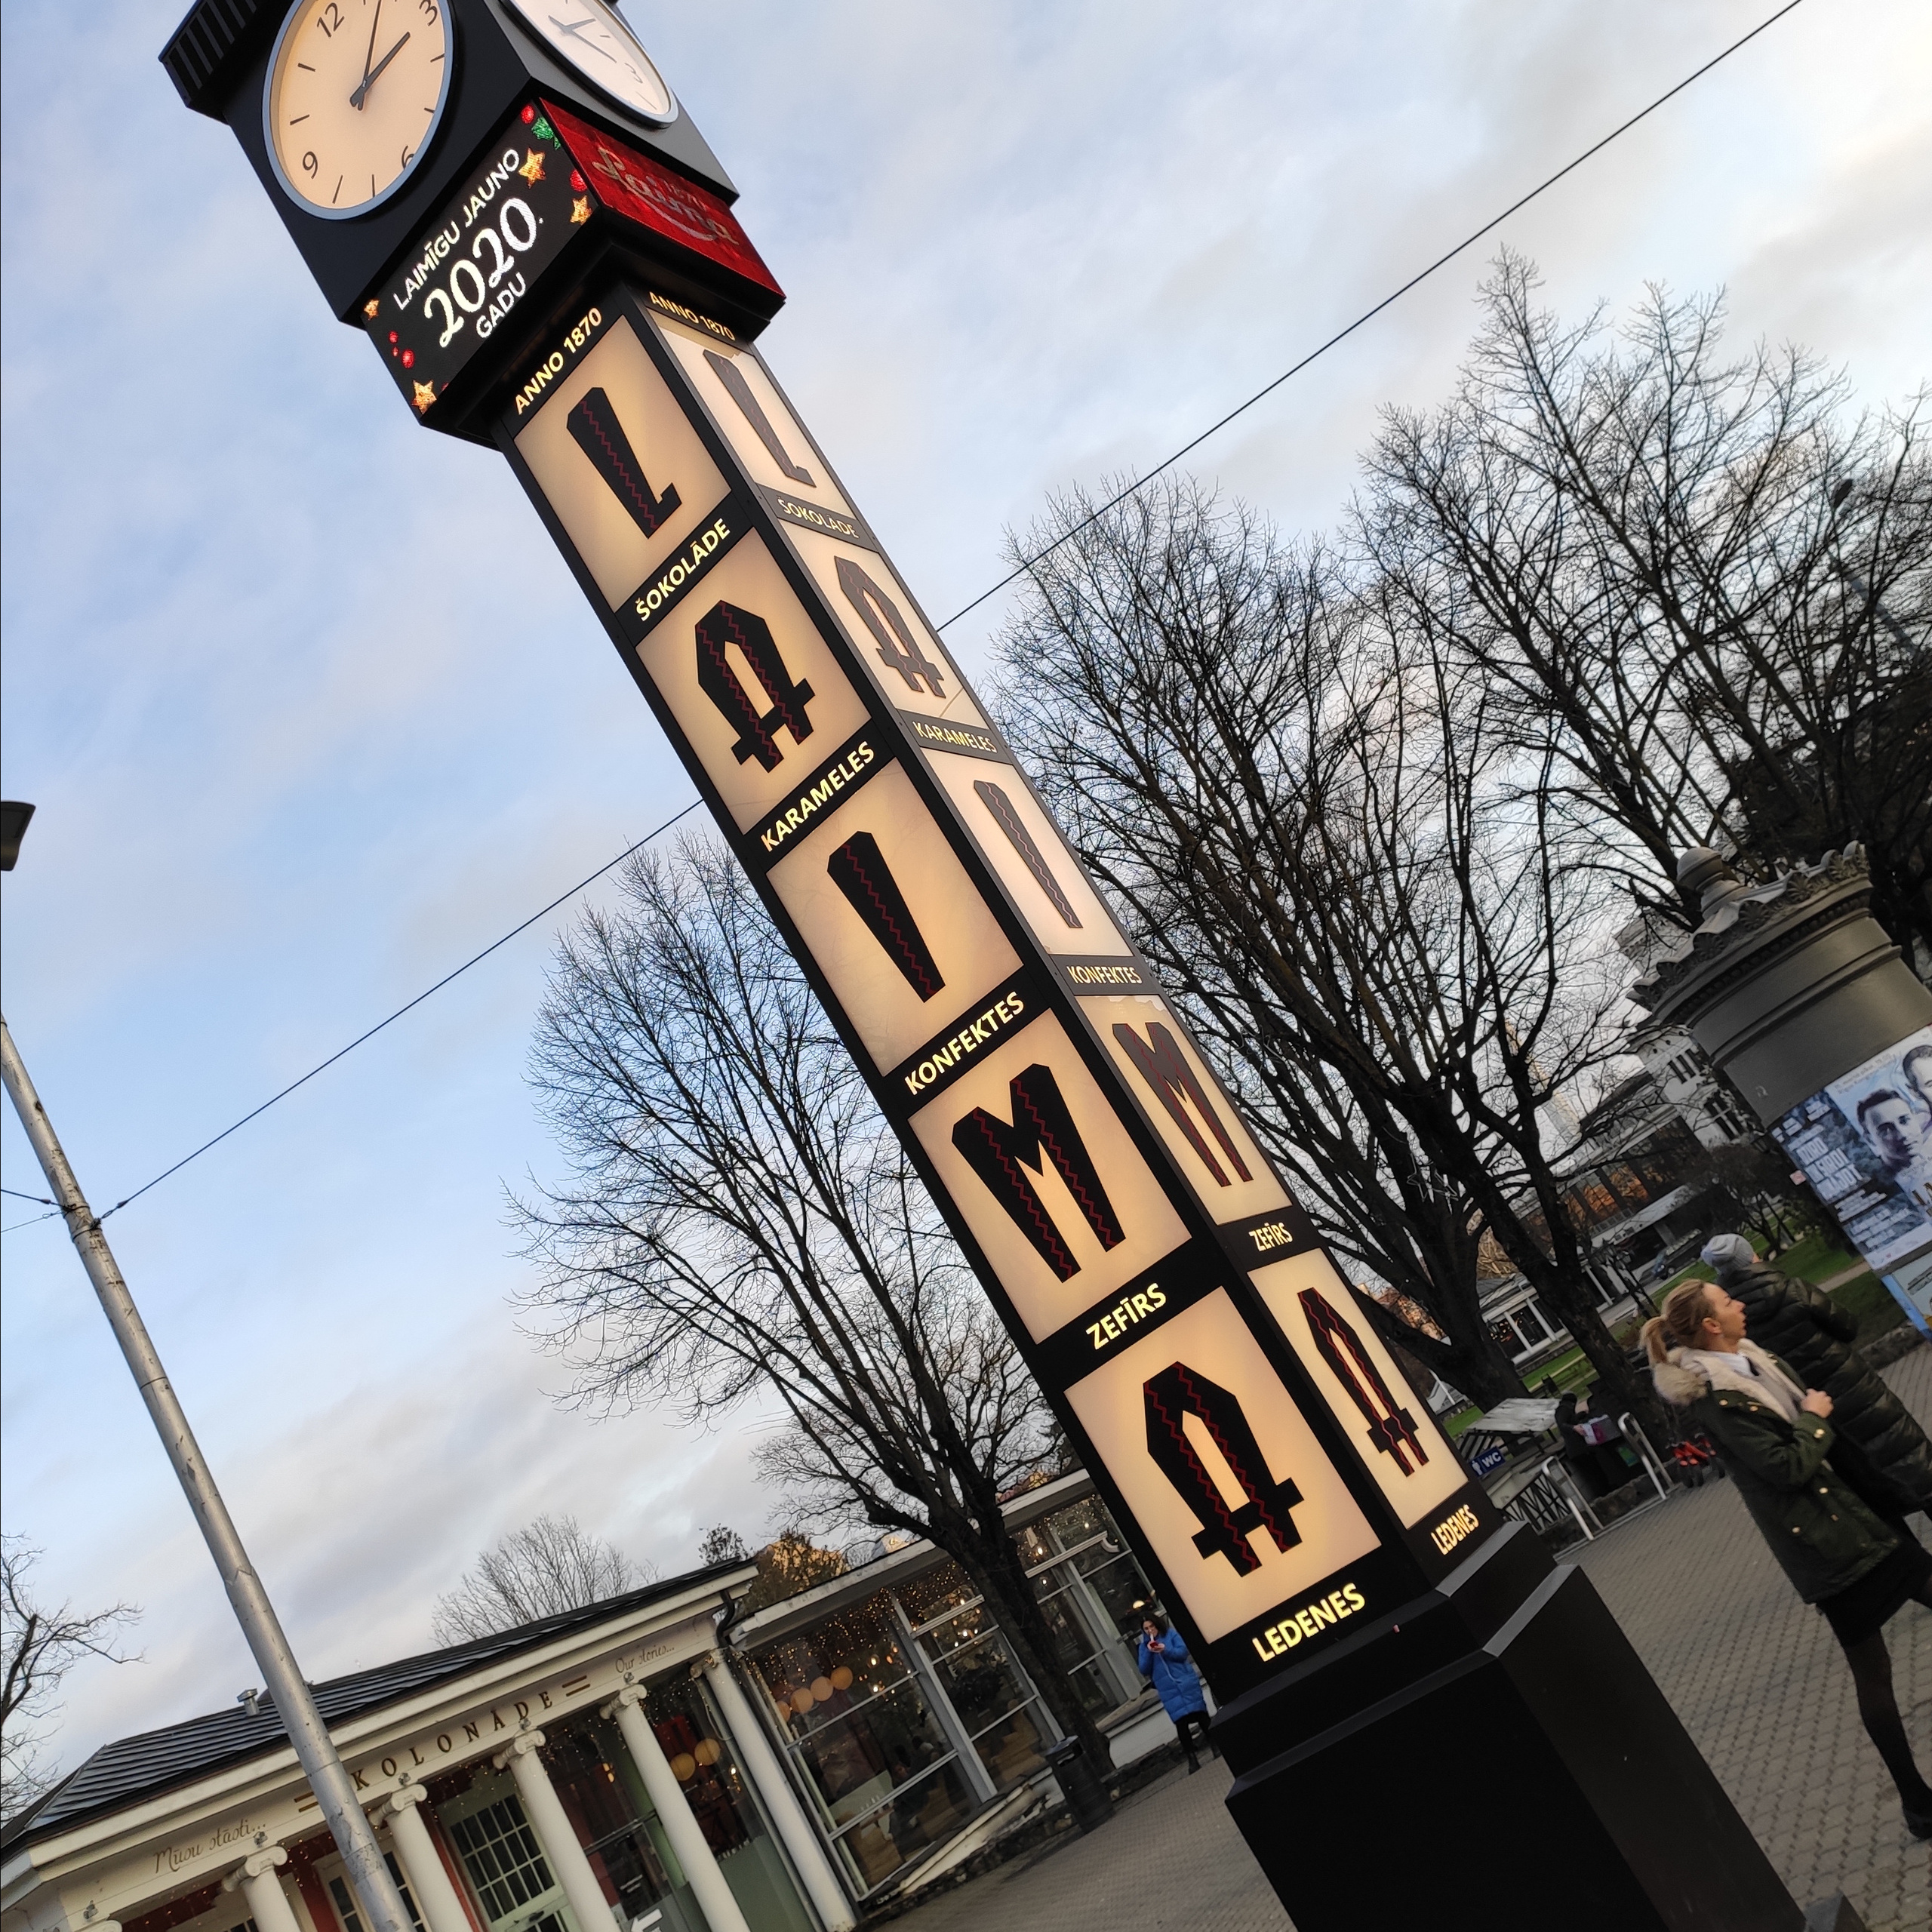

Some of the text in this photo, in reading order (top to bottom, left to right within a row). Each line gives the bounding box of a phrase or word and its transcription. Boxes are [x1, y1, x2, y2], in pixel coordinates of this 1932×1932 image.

[317, 2, 345, 38] 12
[419, 0, 438, 26] 3
[303, 151, 318, 180] 9
[392, 149, 520, 311] LAIMĪGU JAUNO
[475, 272, 527, 339] GADU
[649, 291, 736, 341] ANNO 1870
[515, 307, 602, 415] ANNO 1870
[777, 496, 859, 538] ŠOKOLĀDE
[635, 518, 731, 621] ŠOKOLĀDE
[911, 721, 998, 753] KARAMELES
[760, 740, 875, 852] KARAMELES
[1066, 965, 1143, 984] KONFEKTES
[904, 991, 1024, 1095] KONFEKTES
[1248, 1223, 1293, 1251] ZEFĪRS
[1085, 1283, 1166, 1349] ZEFĪRS
[1481, 1451, 1502, 1468] WC
[1430, 1504, 1479, 1555] LEDENES
[1251, 1582, 1366, 1662] LEDENES
[615, 1657, 635, 1673] Our
